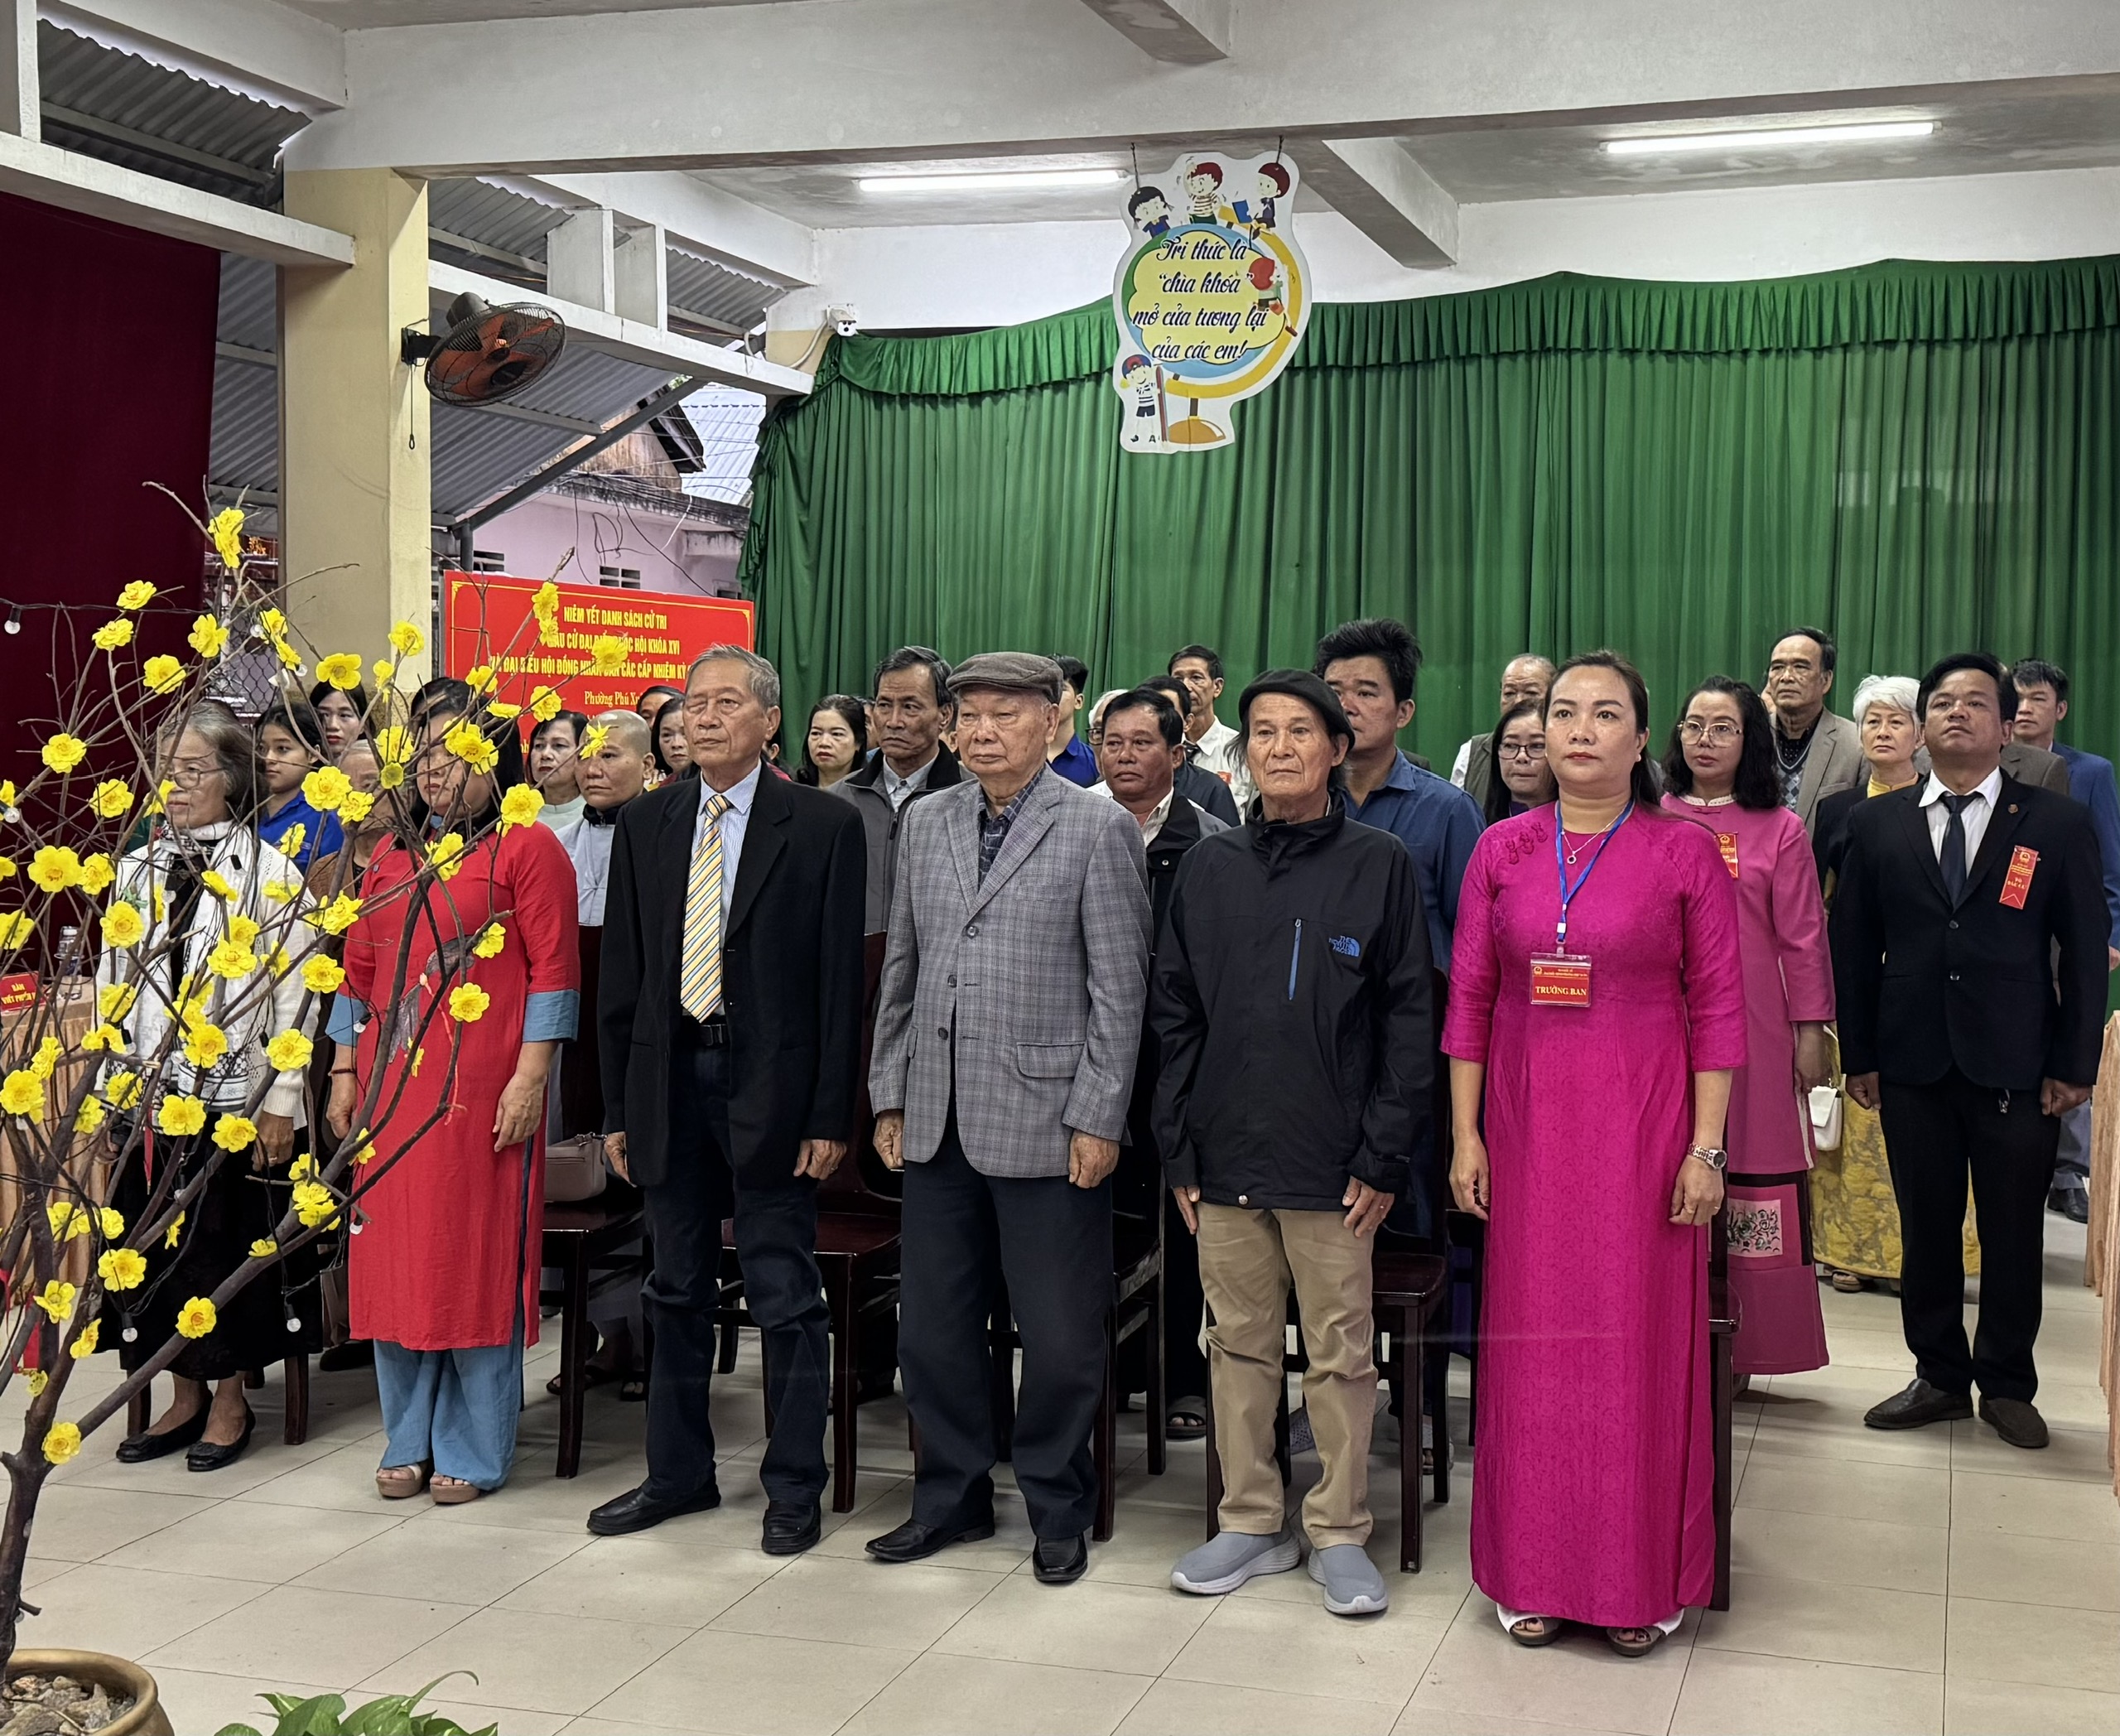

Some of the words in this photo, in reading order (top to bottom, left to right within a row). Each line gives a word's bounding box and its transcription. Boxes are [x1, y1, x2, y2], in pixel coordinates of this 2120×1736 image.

[1191, 238, 1226, 260] thức
[1231, 238, 1248, 260] là
[1132, 302, 1159, 326] mở
[1162, 302, 1191, 326] cửa
[1195, 307, 1241, 334] tương
[1245, 306, 1270, 332] lại
[1151, 335, 1181, 359] của
[1184, 340, 1211, 359] các
[1214, 340, 1249, 359] em!
[585, 604, 600, 625] YẾT
[601, 610, 623, 627] DANH
[624, 609, 643, 629] SÁCH
[644, 609, 655, 629] CỬ
[656, 615, 667, 629] TRI
[566, 627, 579, 649] CỬ
[579, 633, 593, 653] ĐẠI
[634, 634, 647, 657] HỘI
[648, 636, 667, 654] KHÓA
[667, 639, 681, 656] XVI
[503, 656, 518, 677] ĐẠI
[541, 654, 556, 678] HỘI
[621, 658, 636, 678] CÁC
[637, 658, 652, 678] CẤP
[653, 661, 677, 682] NHIỆM
[584, 690, 614, 708] Phường
[614, 691, 629, 706] Phú
